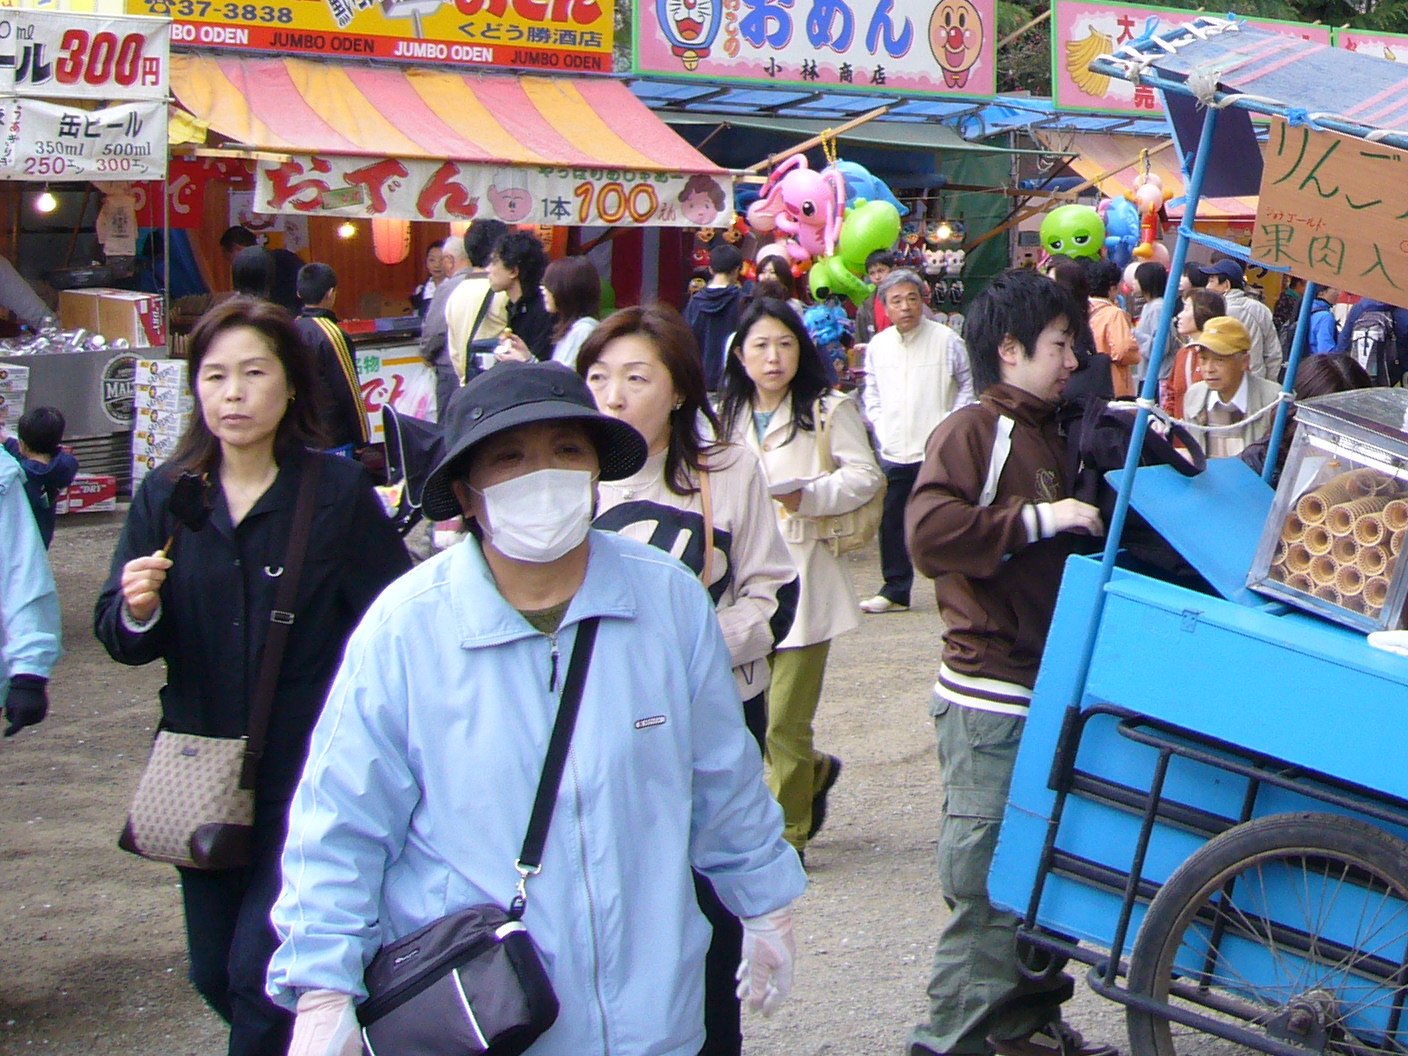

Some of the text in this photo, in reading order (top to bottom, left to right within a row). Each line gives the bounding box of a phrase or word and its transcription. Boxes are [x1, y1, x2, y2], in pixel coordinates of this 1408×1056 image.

[177, 0, 293, 24] 37-3838
[201, 27, 249, 44] ODEN
[269, 32, 326, 50] JUMBO
[328, 36, 375, 53] ODEN
[394, 41, 448, 59] JUMBO
[451, 45, 494, 62] ODEN
[511, 51, 559, 67] JUMBO
[562, 54, 602, 69] ODEN
[458, 21, 604, 48] くどう勝酒店
[55, 29, 161, 86] 300円
[763, 56, 888, 85] 小林商店
[58, 111, 144, 139] 缶ビール
[36, 141, 152, 156] 350ml 500ml
[541, 196, 572, 220] 1本
